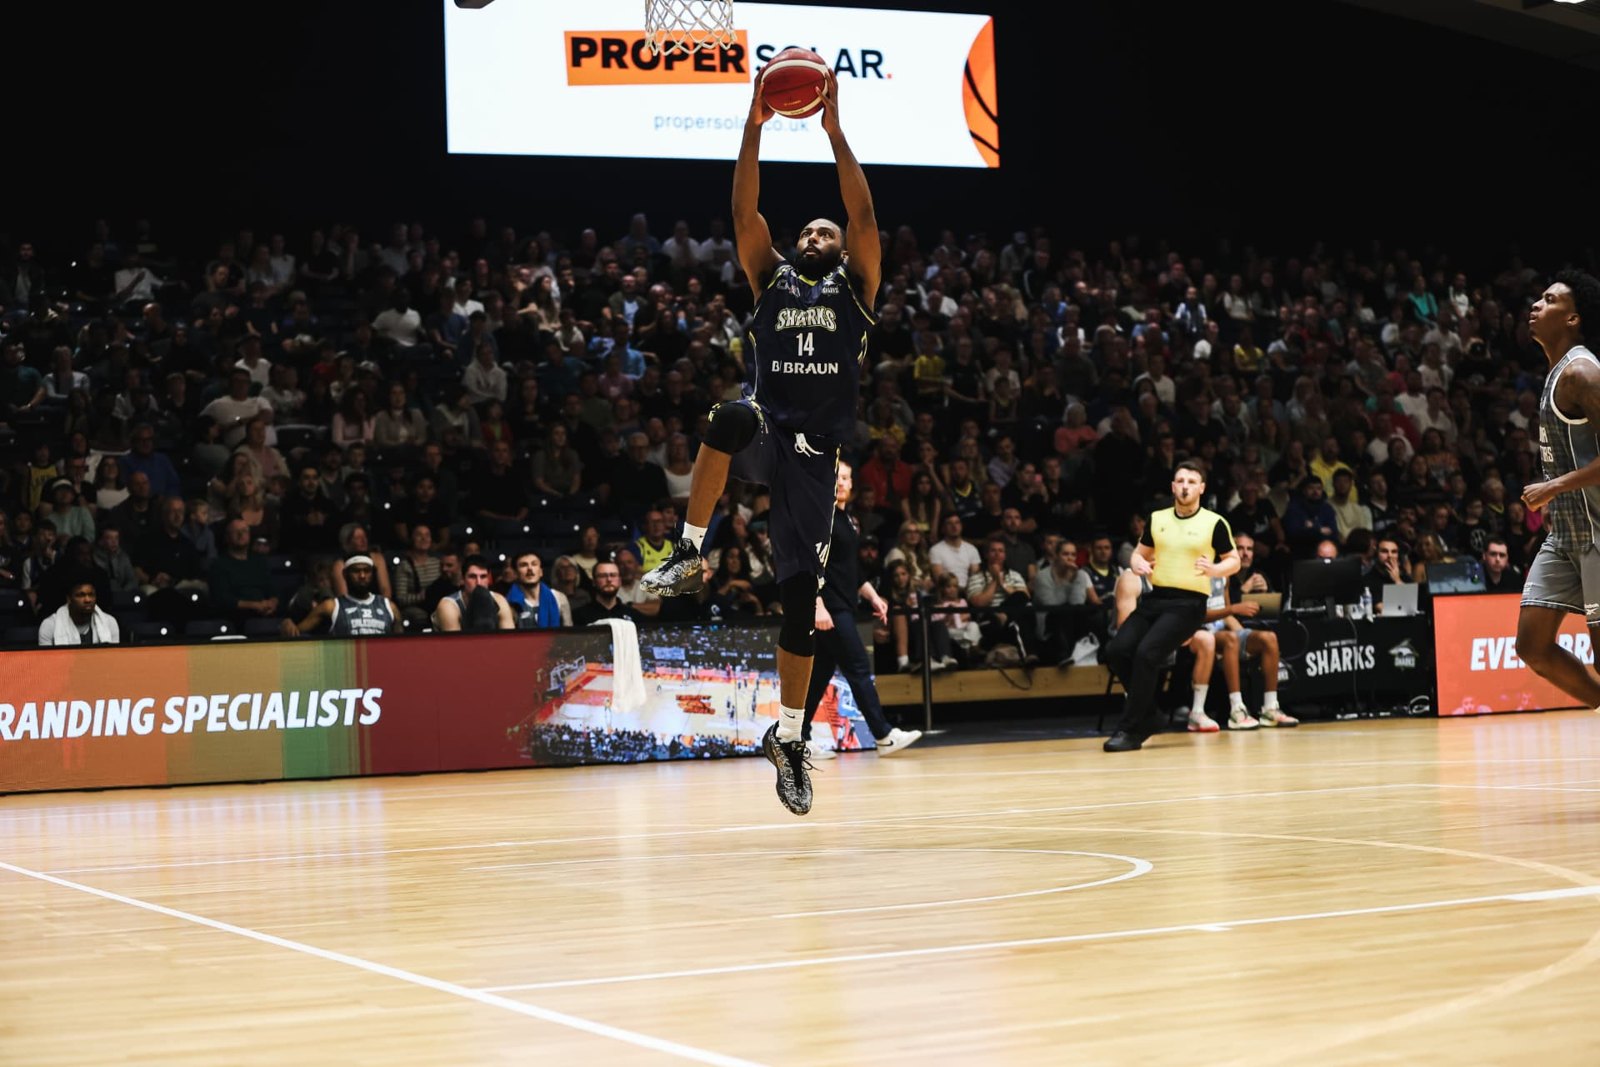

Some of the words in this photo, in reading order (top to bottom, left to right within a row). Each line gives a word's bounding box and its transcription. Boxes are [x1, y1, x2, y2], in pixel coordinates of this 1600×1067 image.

[571, 36, 746, 73] PROPER
[775, 306, 837, 332] SHARKS
[796, 332, 815, 357] 14
[1305, 644, 1376, 677] SHARKS
[0, 698, 155, 740] RANDING
[161, 688, 383, 735] SPECIALISTS
